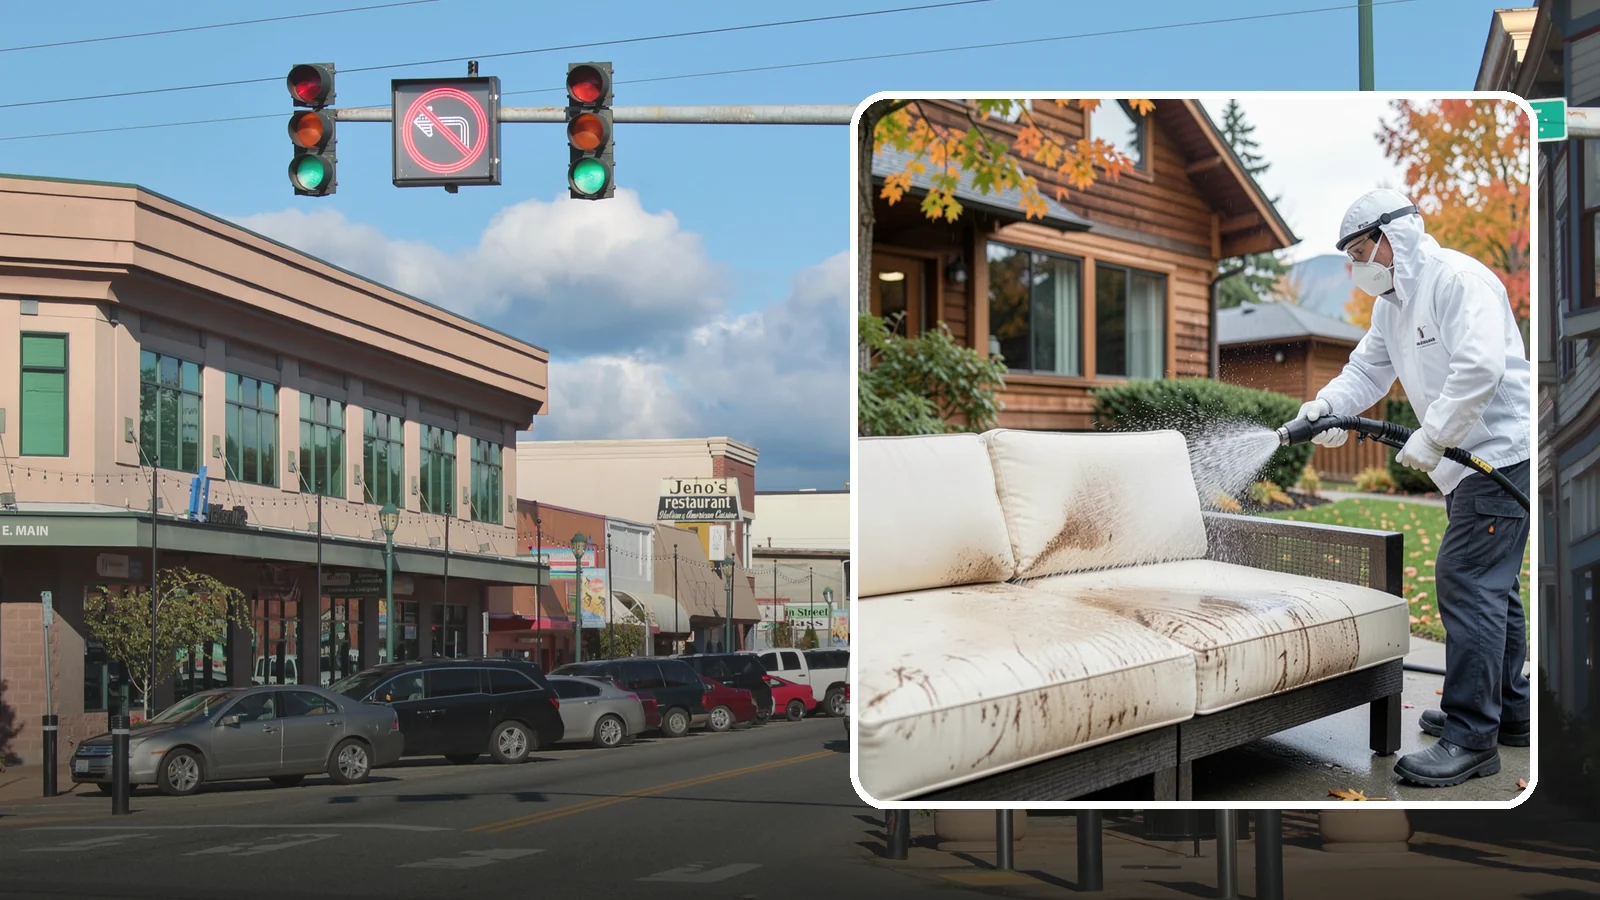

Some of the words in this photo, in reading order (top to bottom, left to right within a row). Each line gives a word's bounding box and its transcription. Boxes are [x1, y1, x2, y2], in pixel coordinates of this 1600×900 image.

[670, 480, 727, 494] Jeno's
[665, 496, 731, 509] restaurant
[659, 510, 681, 519] Italian
[686, 510, 714, 519] American
[715, 509, 737, 519] Cuisine
[2, 525, 13, 536] E.
[15, 525, 49, 536] MAIN
[797, 607, 828, 617] Street
